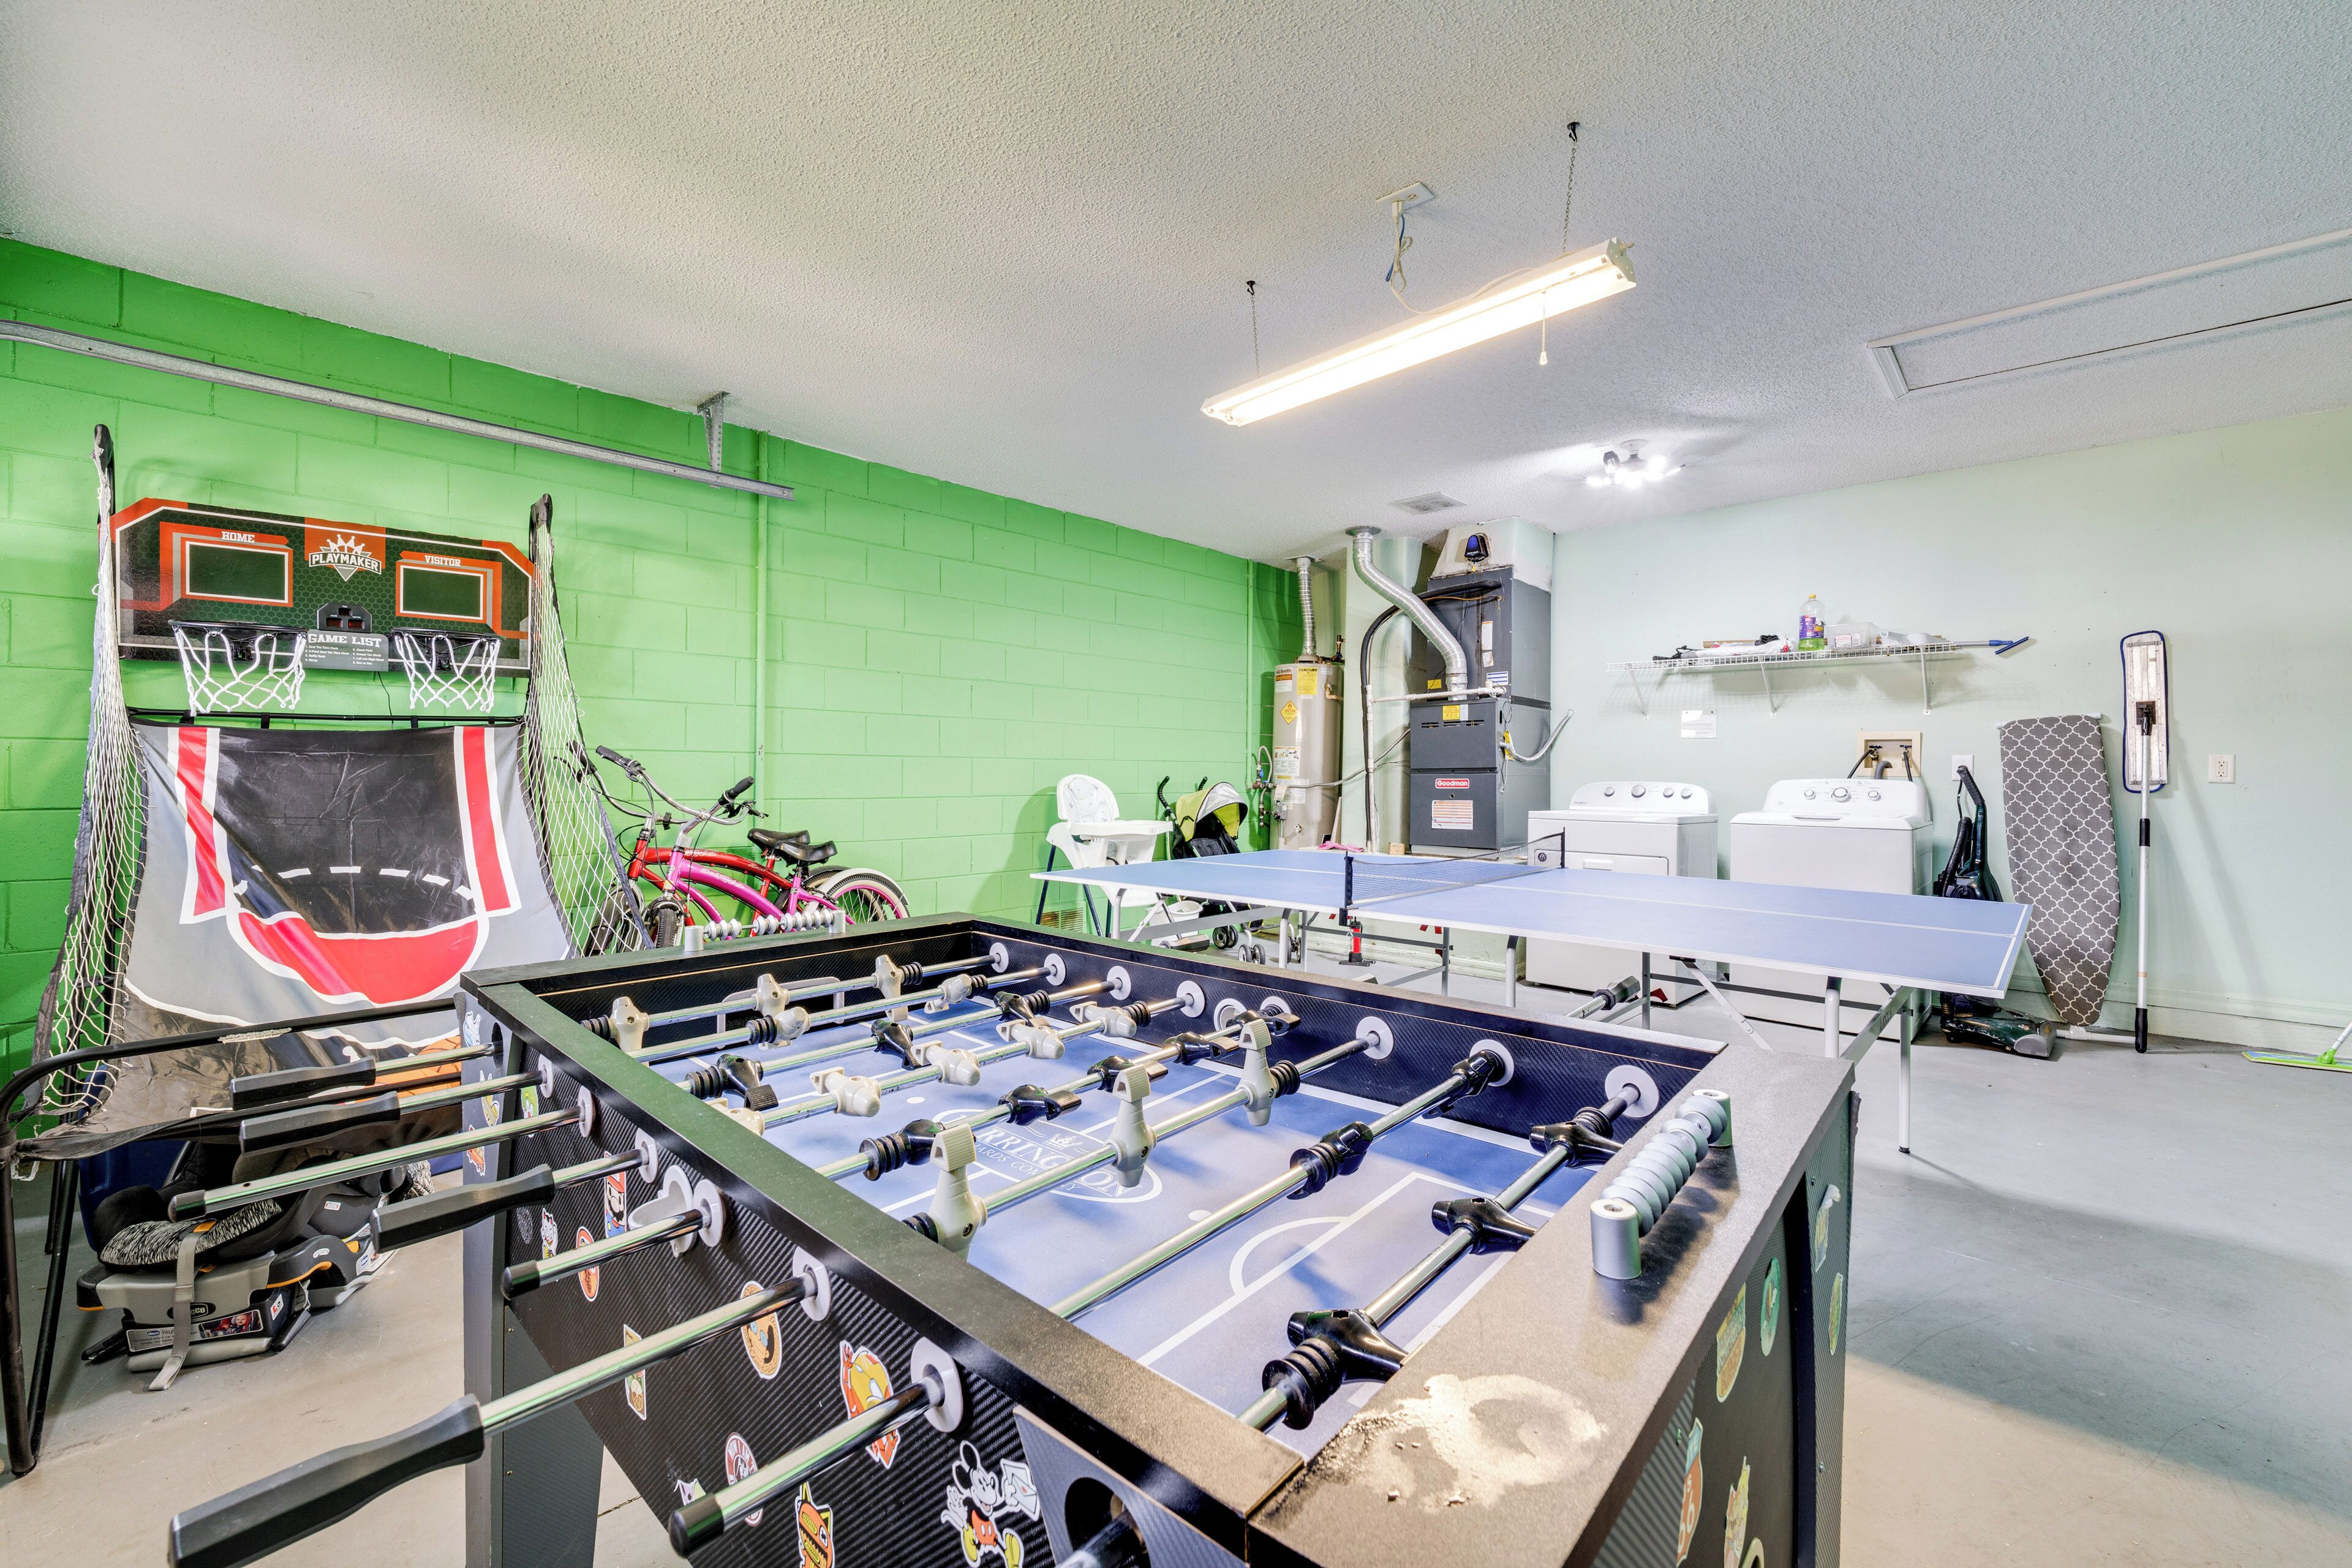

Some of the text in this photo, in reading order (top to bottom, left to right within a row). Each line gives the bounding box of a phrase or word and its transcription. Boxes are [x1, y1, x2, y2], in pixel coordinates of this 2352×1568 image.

[222, 530, 255, 543] HOME
[312, 553, 379, 571] PLAYMAKER
[424, 555, 461, 567] VISITOR
[307, 633, 382, 647] GAME LIST
